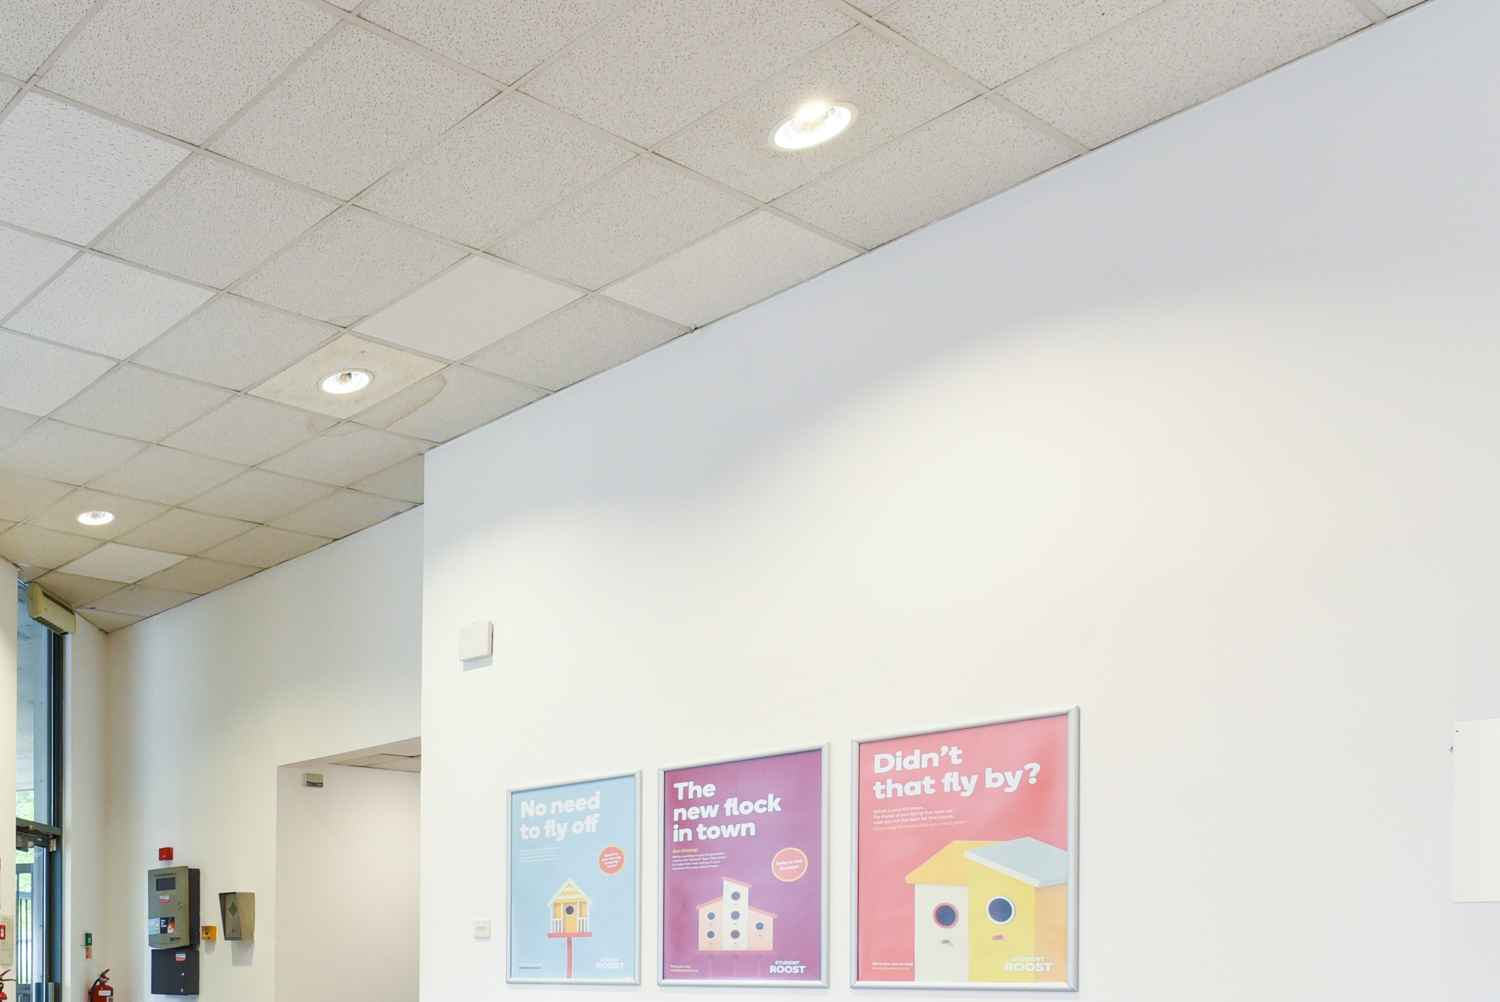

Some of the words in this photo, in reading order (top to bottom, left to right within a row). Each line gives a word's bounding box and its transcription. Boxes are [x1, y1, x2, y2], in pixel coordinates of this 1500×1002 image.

[874, 745, 963, 774] Didn't
[673, 780, 716, 801] The
[872, 776, 936, 799] that
[941, 771, 979, 797] fly
[985, 762, 1041, 793] by?
[520, 799, 547, 818] No
[550, 791, 601, 815] need
[673, 803, 720, 822] new
[723, 793, 782, 816] flock
[520, 823, 541, 840] to
[543, 818, 568, 842] fly
[571, 813, 601, 834] off
[672, 823, 693, 843] in
[696, 821, 756, 840] town
[595, 962, 625, 970] ROOST
[769, 965, 806, 974] ROOST
[1004, 962, 1052, 972] ROOST
